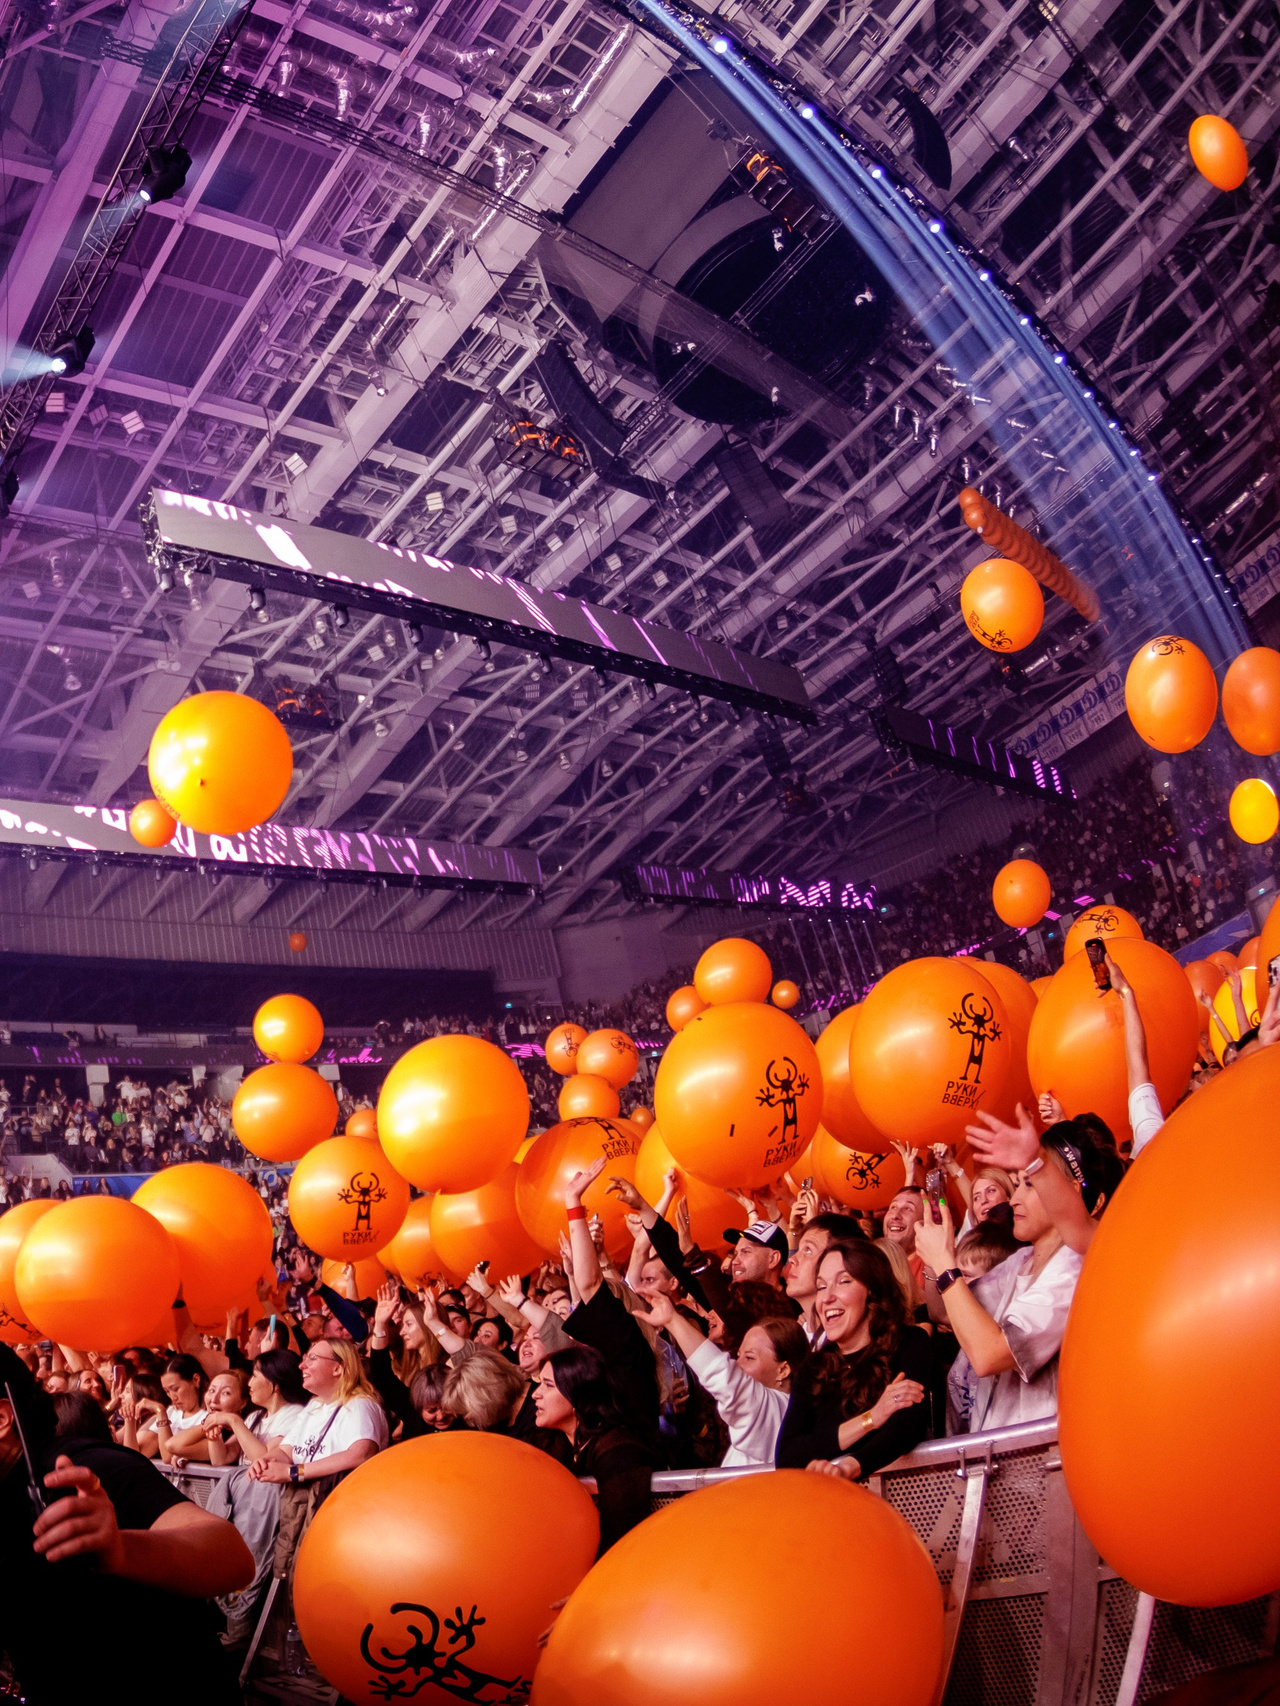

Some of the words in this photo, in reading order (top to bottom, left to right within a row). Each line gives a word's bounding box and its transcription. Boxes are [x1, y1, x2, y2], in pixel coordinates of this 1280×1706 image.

[945, 1080, 978, 1097] РУКИ
[601, 1139, 631, 1153] РУКИ
[765, 1141, 797, 1160] РУКИ
[343, 1231, 371, 1240] РУКИ
